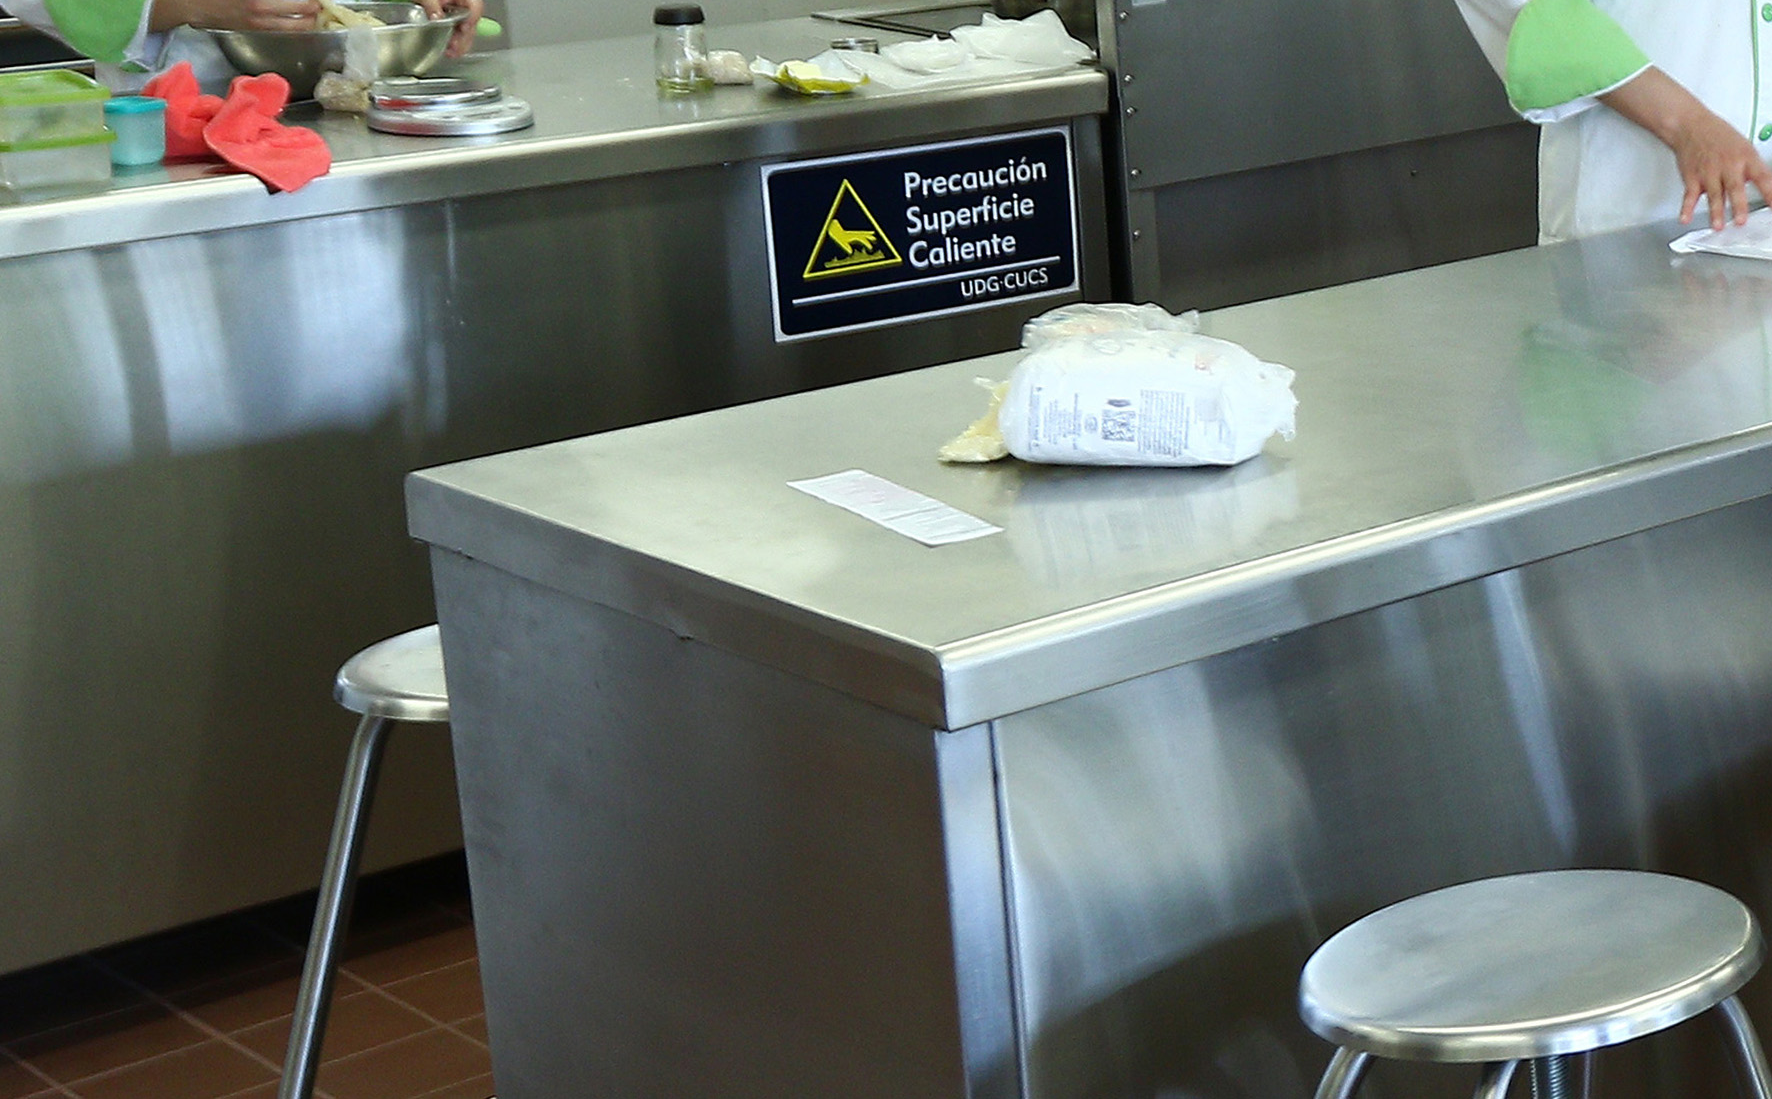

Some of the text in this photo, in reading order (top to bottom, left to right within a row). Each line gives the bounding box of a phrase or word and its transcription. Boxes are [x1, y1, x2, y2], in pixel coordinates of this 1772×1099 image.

[903, 155, 1048, 199] Precaución
[906, 192, 1035, 236] Superficie
[908, 233, 1017, 269] Caliente
